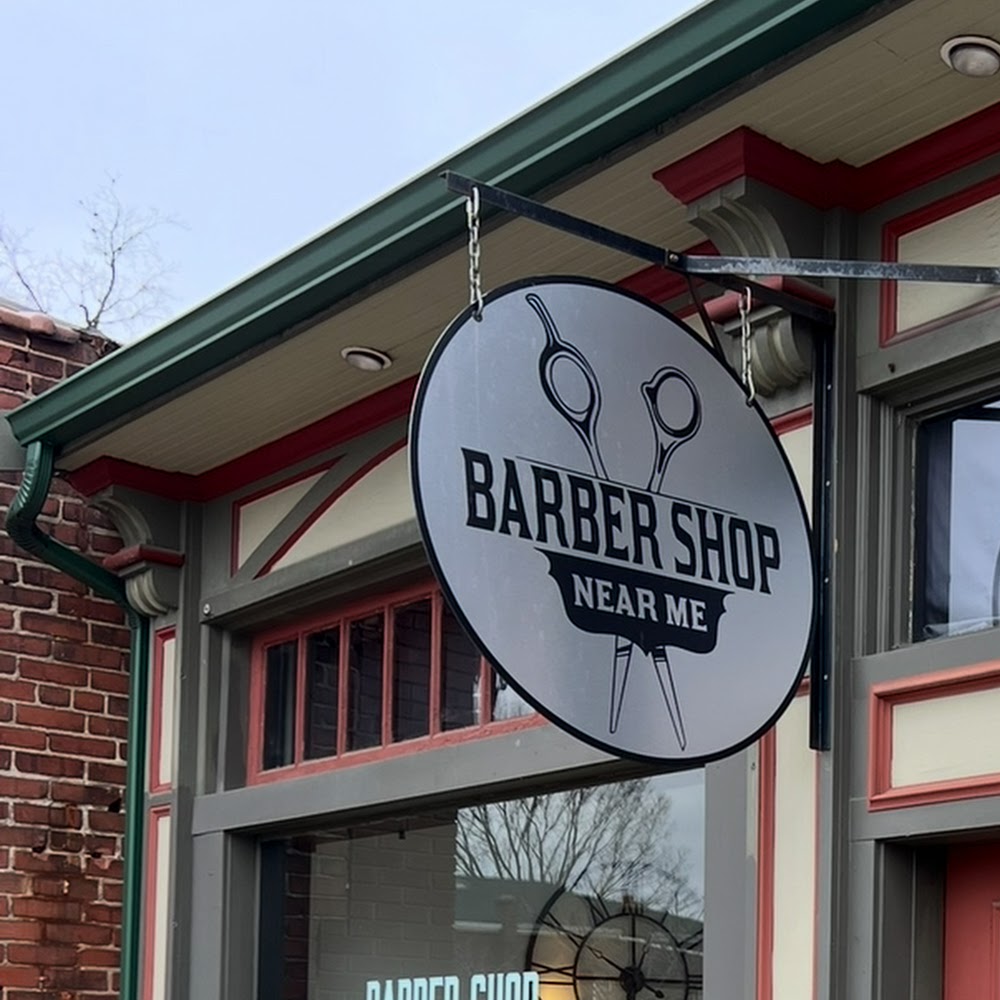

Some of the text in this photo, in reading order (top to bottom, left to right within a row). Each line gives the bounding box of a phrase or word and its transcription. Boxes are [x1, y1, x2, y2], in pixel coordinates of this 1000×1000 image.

[460, 447, 782, 595] BARBER SHOP
[571, 572, 708, 632] NEAR ME
